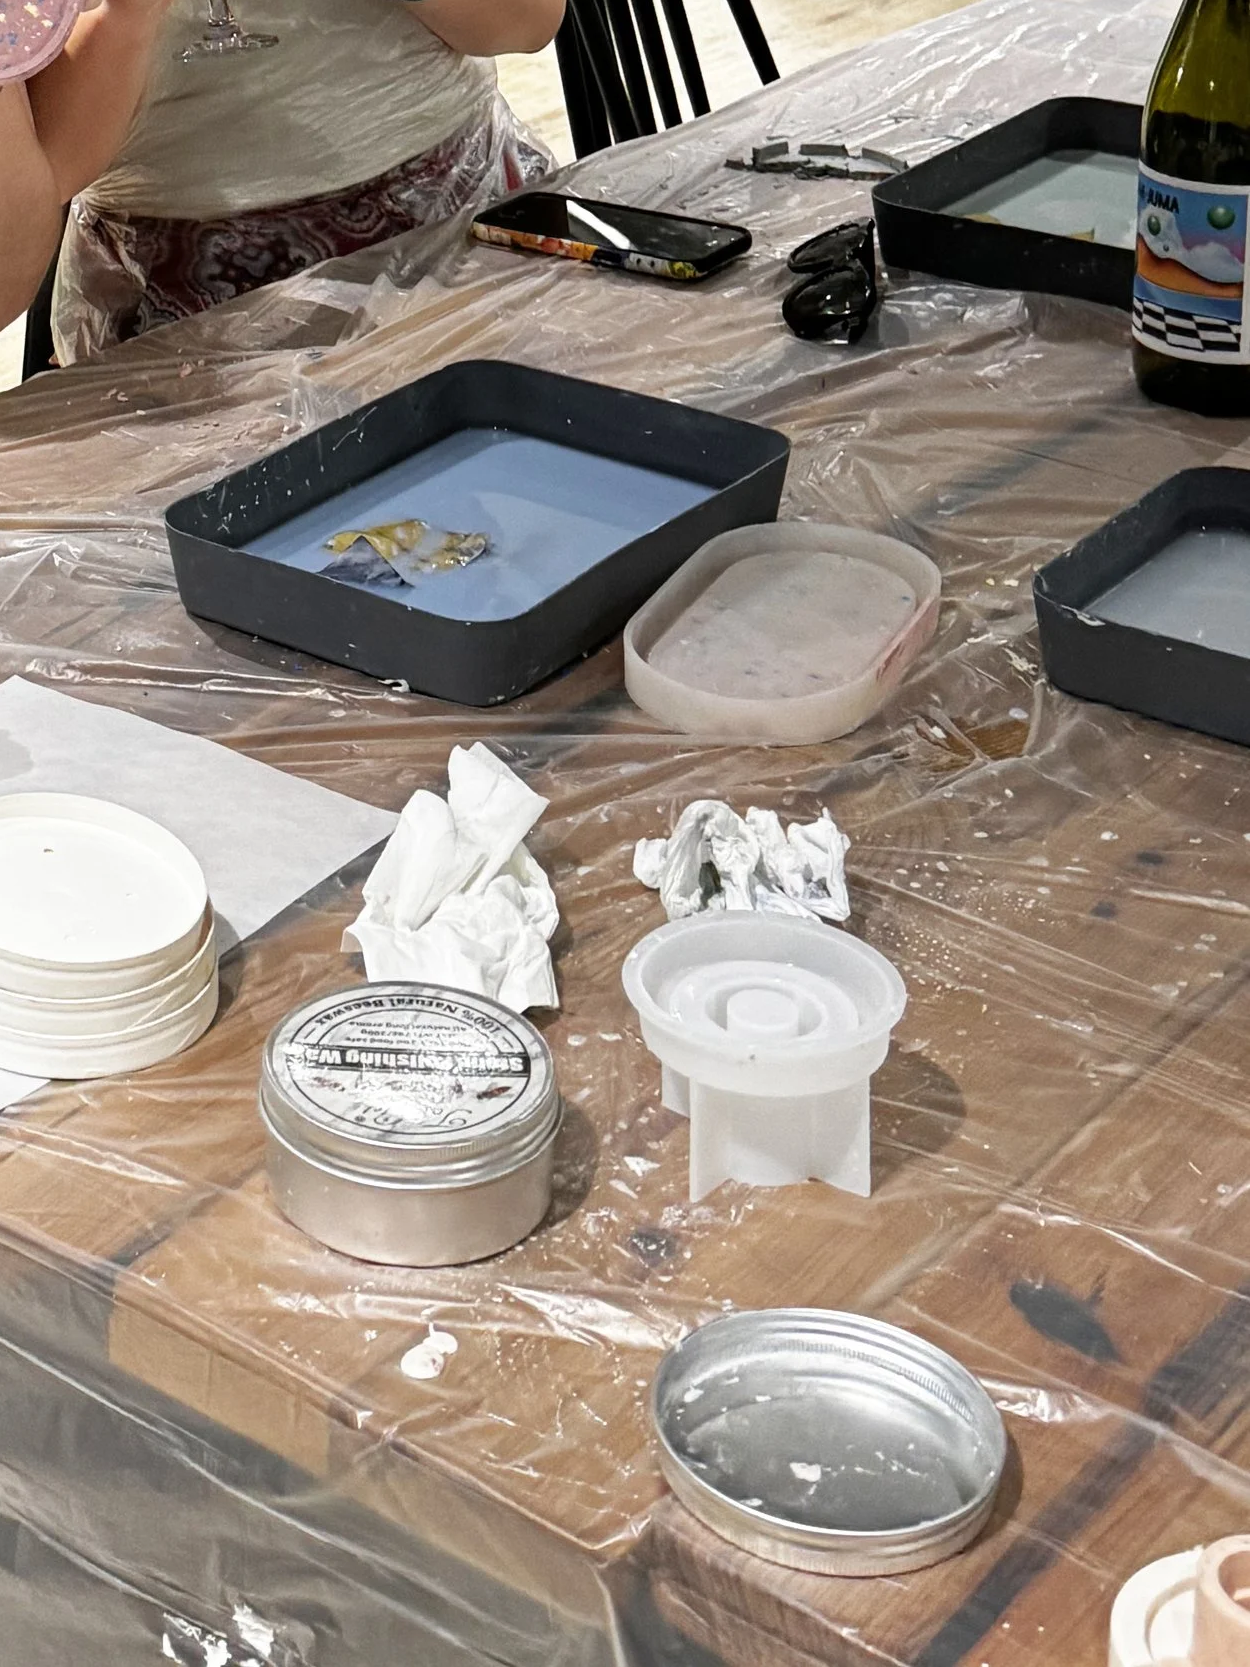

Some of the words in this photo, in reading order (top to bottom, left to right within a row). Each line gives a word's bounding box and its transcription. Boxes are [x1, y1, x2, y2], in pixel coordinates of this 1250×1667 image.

[314, 998, 385, 1026] Beeswax
[389, 997, 458, 1015] Natural
[460, 1009, 502, 1034] 100%
[293, 1045, 342, 1065] Wa
